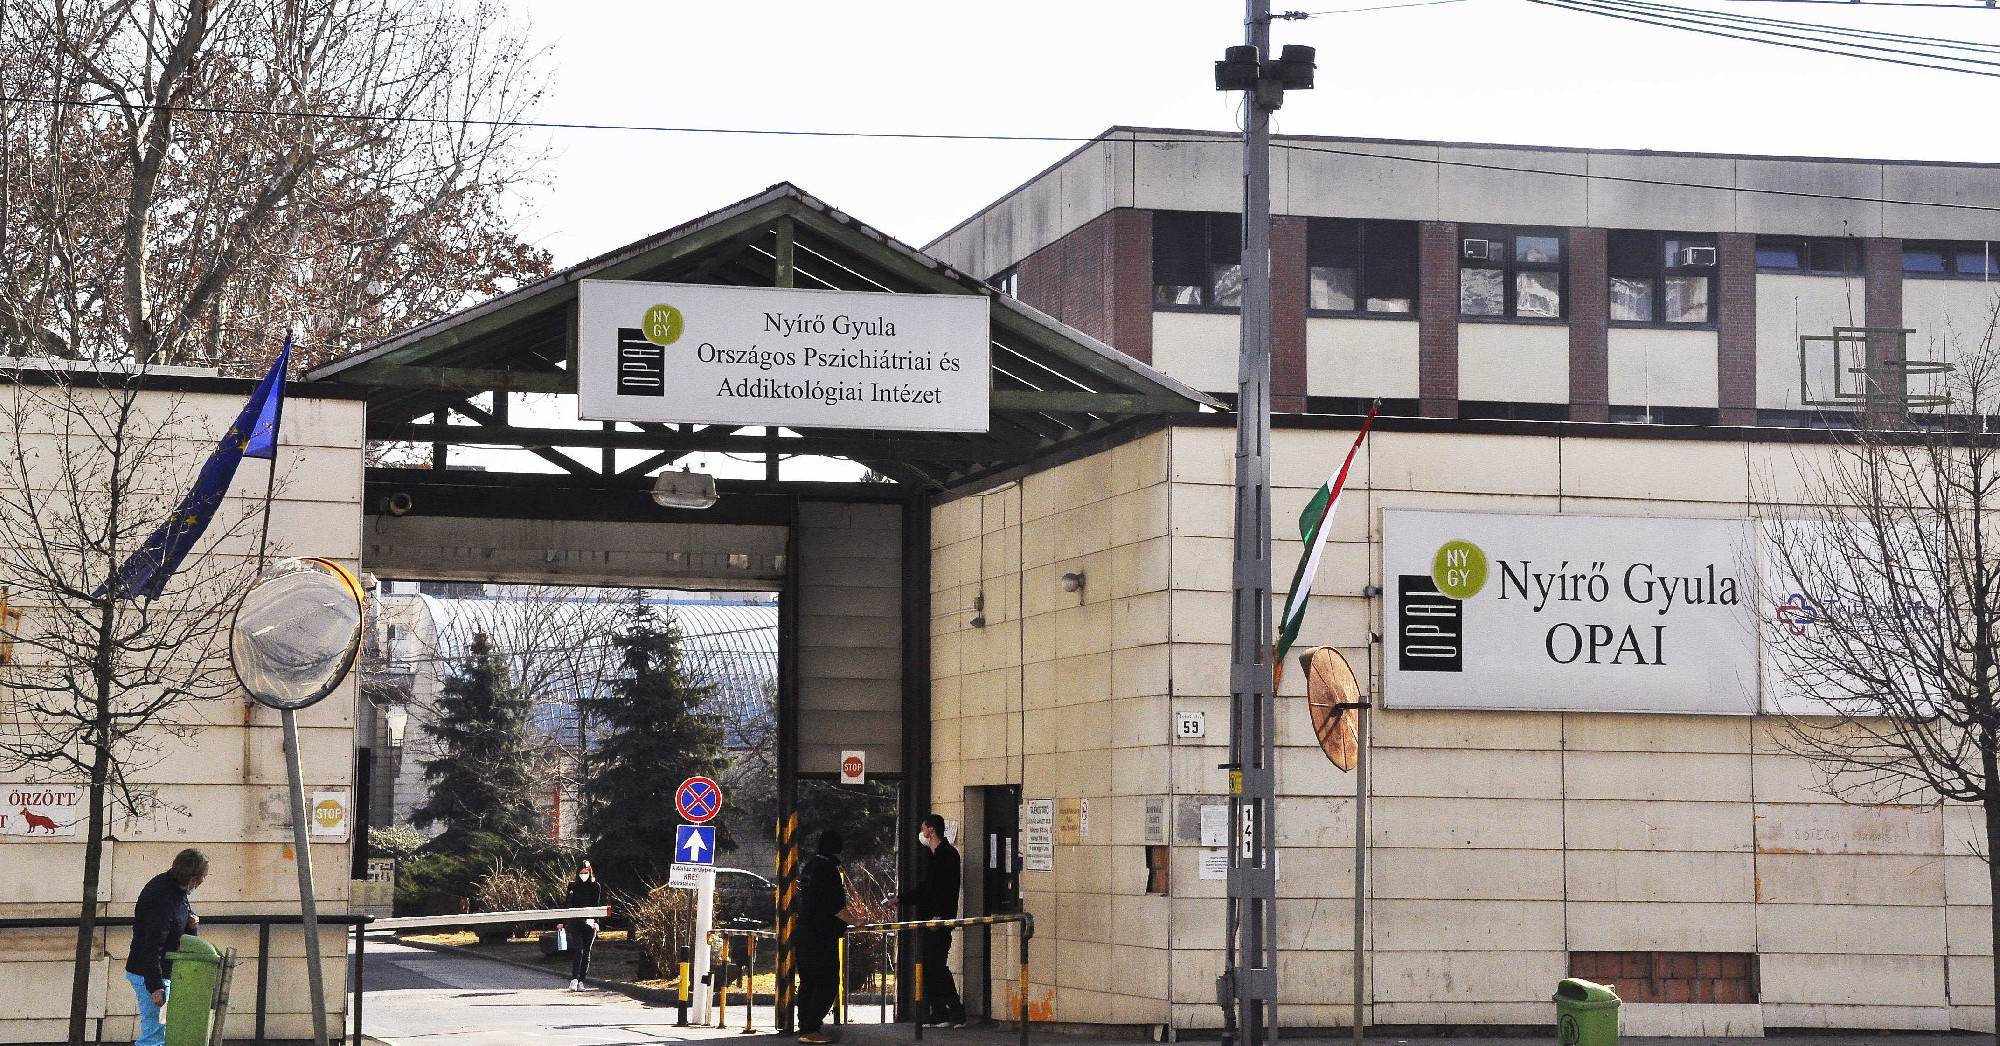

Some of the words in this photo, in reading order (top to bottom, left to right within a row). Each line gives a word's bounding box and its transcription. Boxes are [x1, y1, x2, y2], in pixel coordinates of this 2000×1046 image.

[653, 310, 670, 323] NY
[653, 324, 669, 337] GY
[764, 312, 825, 338] Nyírő
[832, 315, 896, 341] Gyula
[622, 338, 660, 387] OPAI
[697, 342, 796, 371] Országos
[804, 347, 932, 371] Pszichiátriai
[939, 351, 960, 372] és
[716, 377, 863, 406] Addiktológiai
[871, 382, 942, 404] Intézet
[1447, 549, 1470, 567] NY
[1447, 569, 1470, 587] GY
[1496, 560, 1609, 613] Nyírő
[1623, 562, 1740, 616] Gyula
[1405, 590, 1457, 658] OPAI
[1545, 622, 1668, 666] OPAI
[1183, 720, 1198, 734] 59
[844, 763, 862, 772] STOP
[316, 808, 342, 819] STOP
[1244, 808, 1252, 853] 141
